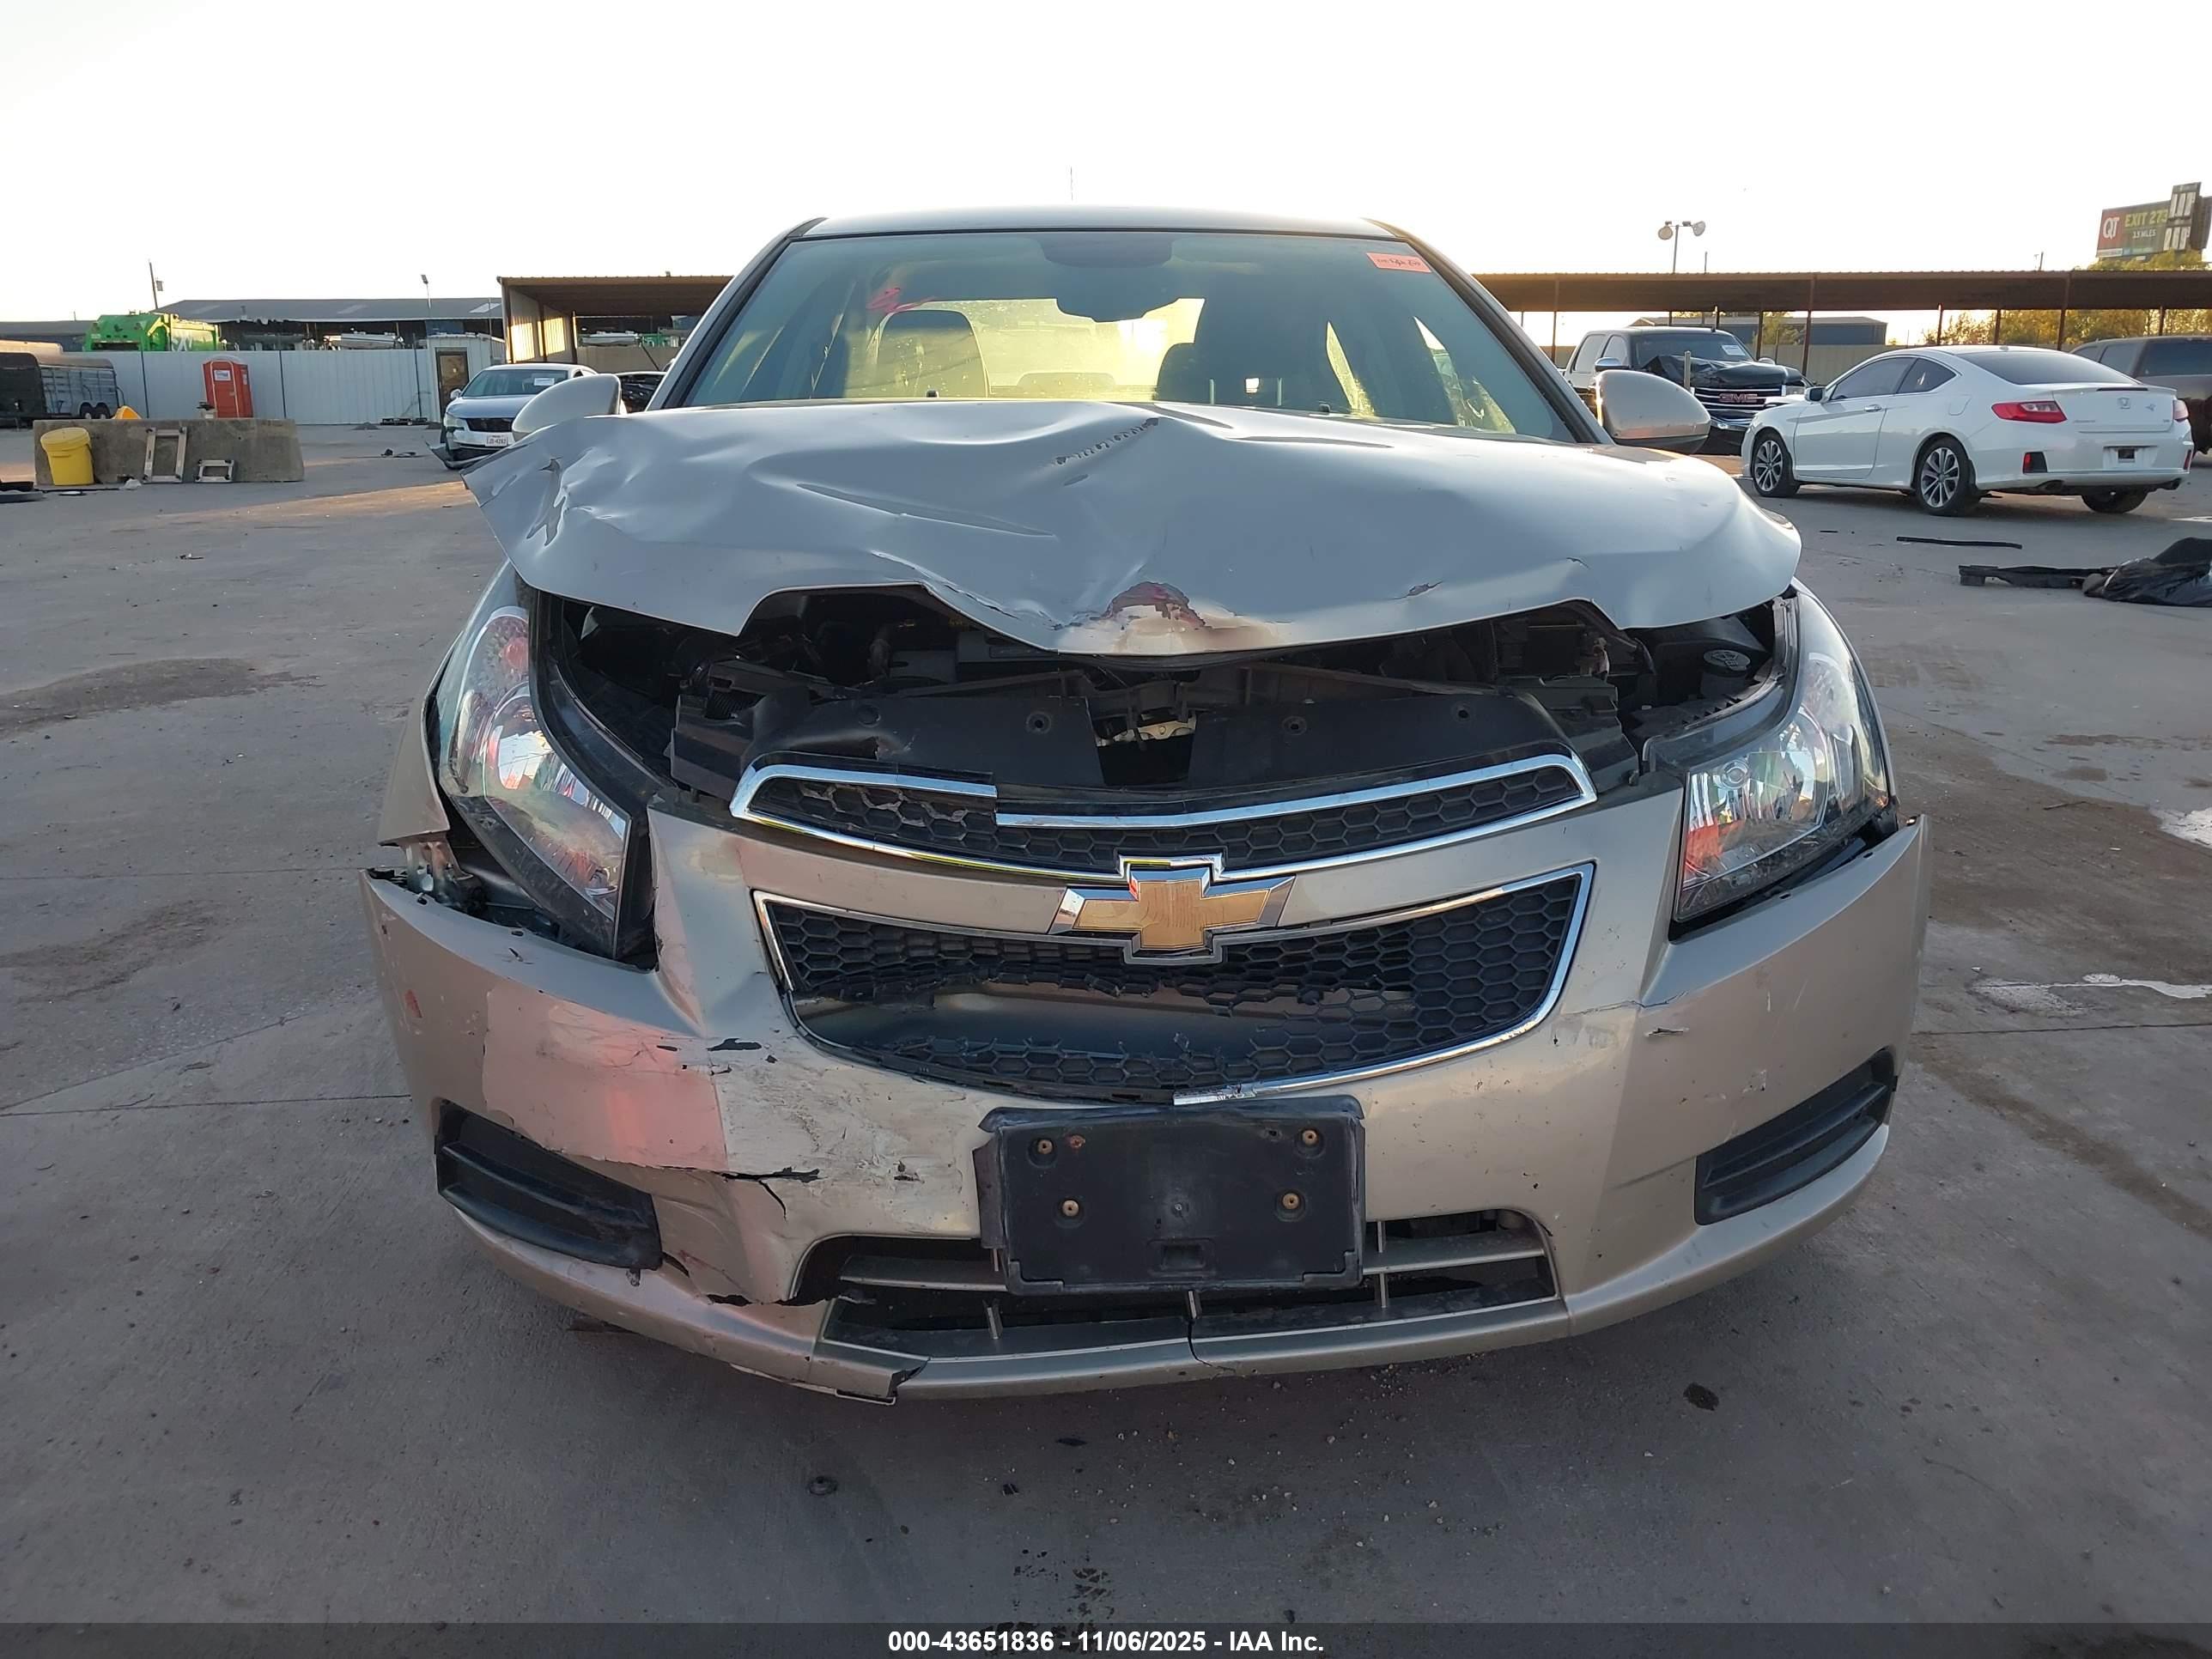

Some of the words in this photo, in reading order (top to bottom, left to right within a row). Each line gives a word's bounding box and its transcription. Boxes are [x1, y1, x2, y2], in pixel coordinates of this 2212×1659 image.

[2102, 216, 2120, 240] QT
[2124, 212, 2148, 228] EXIT
[2149, 209, 2169, 224] 273
[1719, 393, 1758, 404] GMC
